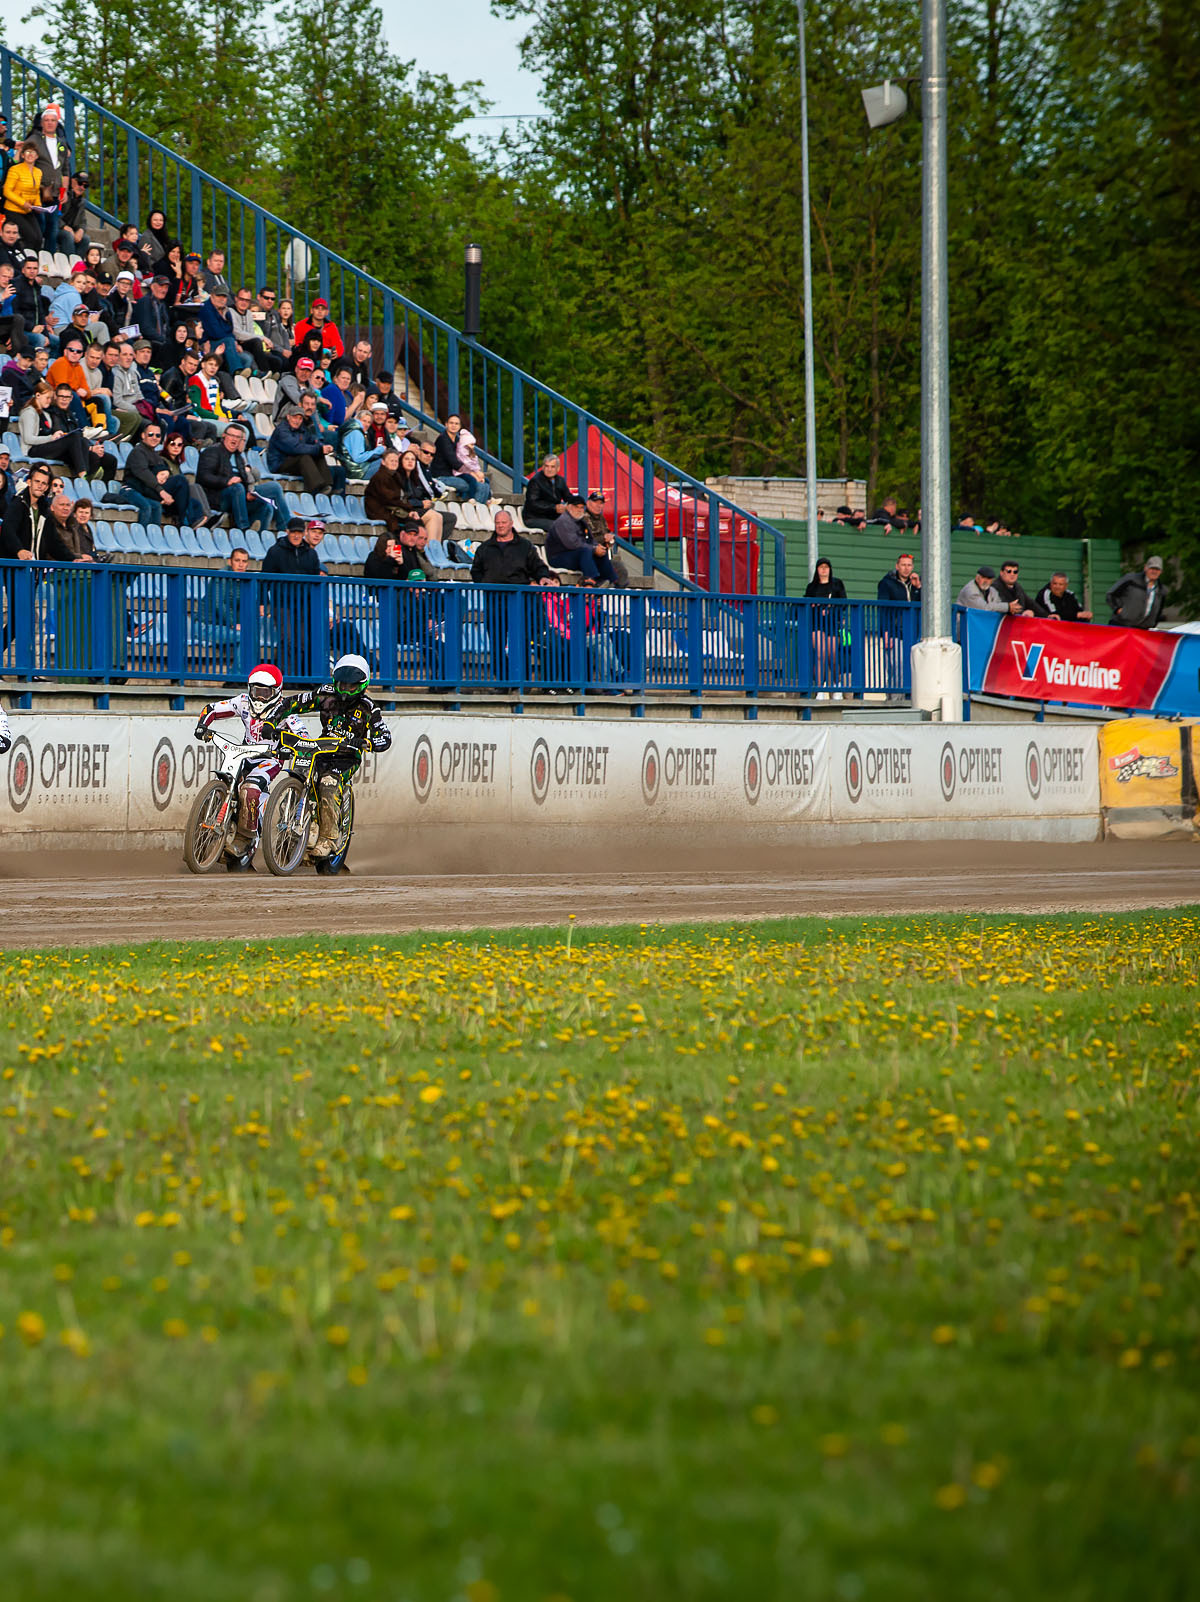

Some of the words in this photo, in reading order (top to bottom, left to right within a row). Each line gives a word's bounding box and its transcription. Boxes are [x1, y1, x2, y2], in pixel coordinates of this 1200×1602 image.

[1043, 656, 1121, 690] Valvoline
[40, 742, 110, 789] OPTIBET
[439, 741, 497, 783] OPTIBET
[555, 745, 609, 785] OPTIBET
[665, 747, 717, 786] OPTIBET
[765, 748, 815, 786] OPTIBET
[866, 747, 912, 784] OPTIBET
[960, 747, 1003, 783] OPTIBET
[1043, 747, 1084, 782] OPTIBET
